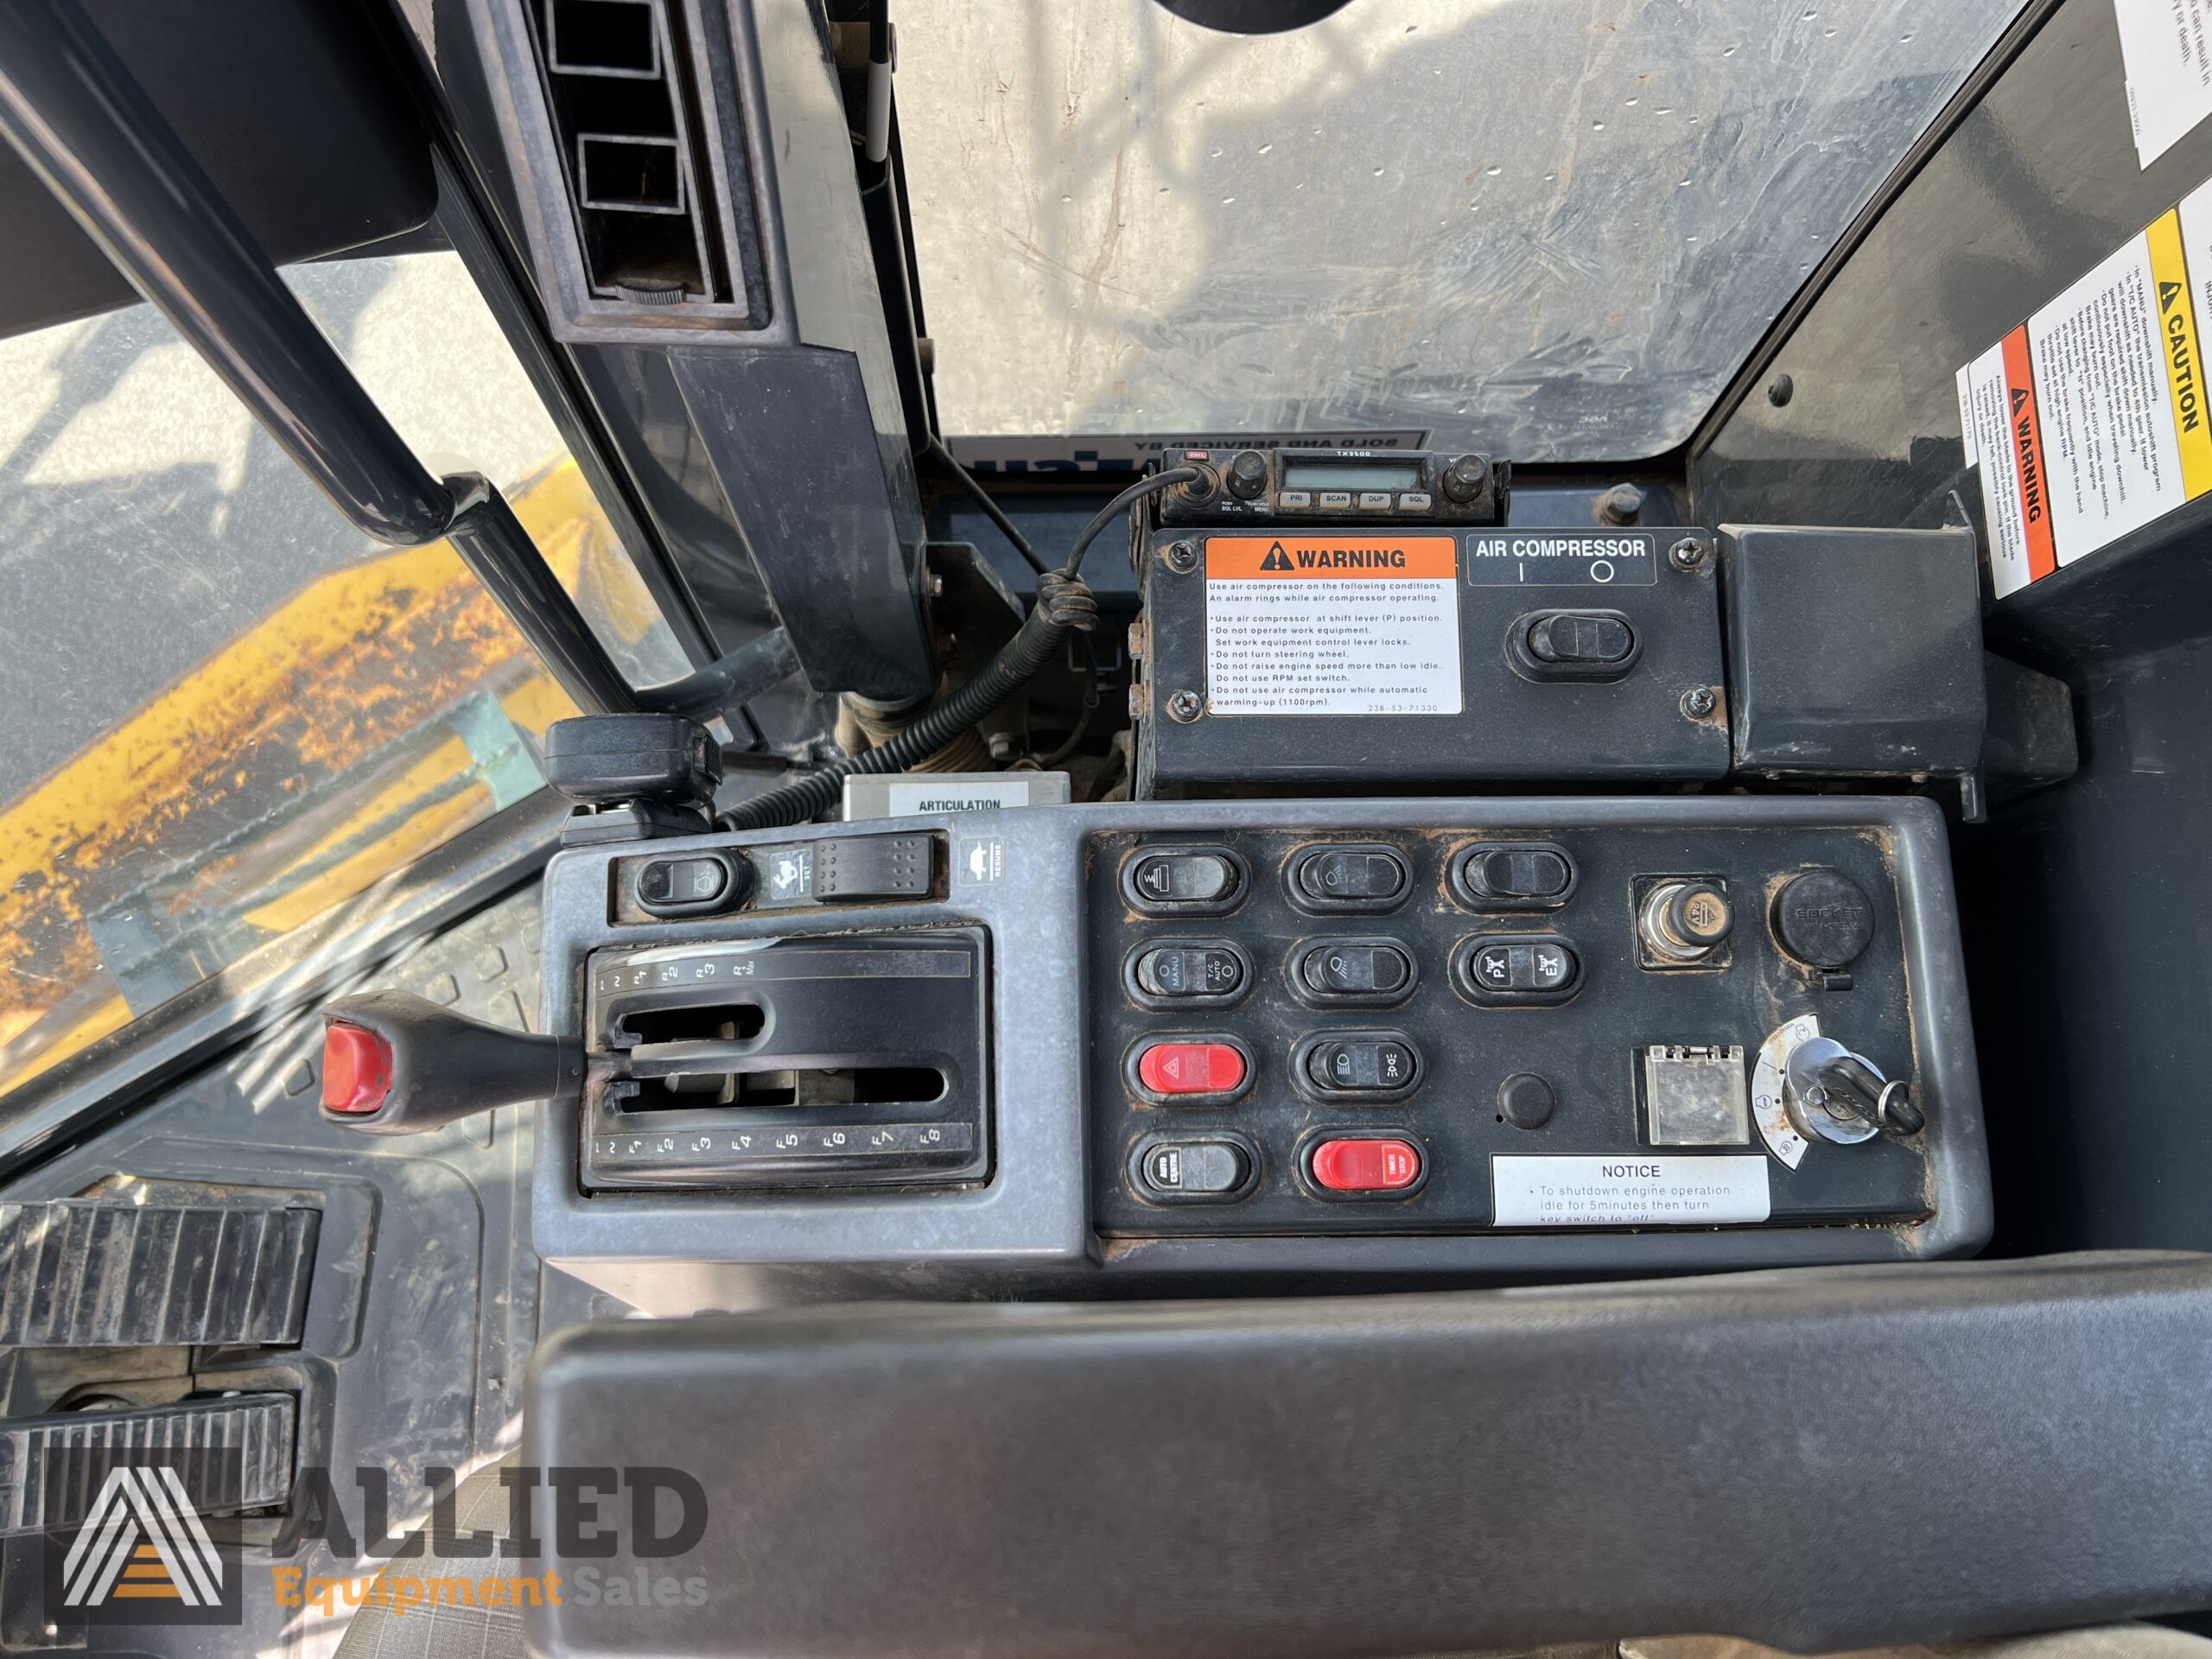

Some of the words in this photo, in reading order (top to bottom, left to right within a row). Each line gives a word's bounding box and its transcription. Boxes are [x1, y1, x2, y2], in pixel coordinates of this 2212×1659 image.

[2133, 267, 2140, 278] In
[2101, 292, 2107, 307] Do
[2135, 277, 2146, 315] "MANU"
[2103, 322, 2112, 339] put
[2140, 315, 2152, 360] downshift
[2107, 337, 2115, 358] foot
[2109, 357, 2116, 371] on
[2168, 314, 2199, 433] CAUTION
[2145, 360, 2159, 405] manually.
[2113, 385, 2123, 412] brake
[2116, 411, 2126, 438] pedal
[2018, 416, 2041, 524] WARNING
[1476, 540, 1507, 557] AIR
[1512, 539, 1645, 556] COMPRESSOR
[1297, 550, 1406, 569] WARNING
[1209, 582, 1227, 591] Use
[1246, 582, 1304, 592] compressor
[1340, 582, 1386, 591] following
[1389, 582, 1444, 590] conditions.
[1255, 594, 1281, 605] rings
[1329, 594, 1387, 603] compressor
[1252, 615, 1310, 624] compressor
[1355, 614, 1379, 623] lever
[1382, 613, 1396, 622] (P)
[1400, 614, 1442, 623] position.
[1215, 626, 1229, 635] Do
[1250, 627, 1287, 637] operate
[1291, 626, 1314, 635] work
[1317, 626, 1371, 636] equipment.
[1234, 638, 1258, 647] work
[1261, 639, 1312, 648] equipment
[1382, 638, 1410, 648] locks.
[1274, 650, 1314, 659] steering
[1279, 663, 1313, 671] engine
[1315, 663, 1344, 671] speed
[1272, 674, 1294, 684] RPM
[1297, 675, 1312, 683] set
[1216, 685, 1230, 695] Do
[1288, 685, 1346, 696] compressor
[1350, 685, 1376, 694] while
[1379, 685, 1427, 694] automatic
[1216, 697, 1275, 708] warming-up
[1279, 697, 1331, 708] (1100rpm).
[918, 799, 1001, 811] ARTICULATION
[1691, 903, 1700, 925] 24V
[1796, 907, 1863, 919] SOCKET
[1160, 1157, 1168, 1179] AUTO
[1603, 1165, 1661, 1178] NOTICE
[1541, 1186, 1554, 1196] To
[1559, 1185, 1619, 1196] shutdown
[1624, 1185, 1666, 1198] engine
[1671, 1185, 1730, 1198] operation
[1541, 1200, 1562, 1211] idle
[1568, 1200, 1585, 1211] for
[1590, 1200, 1646, 1211] 5minutes
[1652, 1200, 1679, 1211] then
[1684, 1200, 1709, 1210] turn
[1540, 1214, 1560, 1223] key
